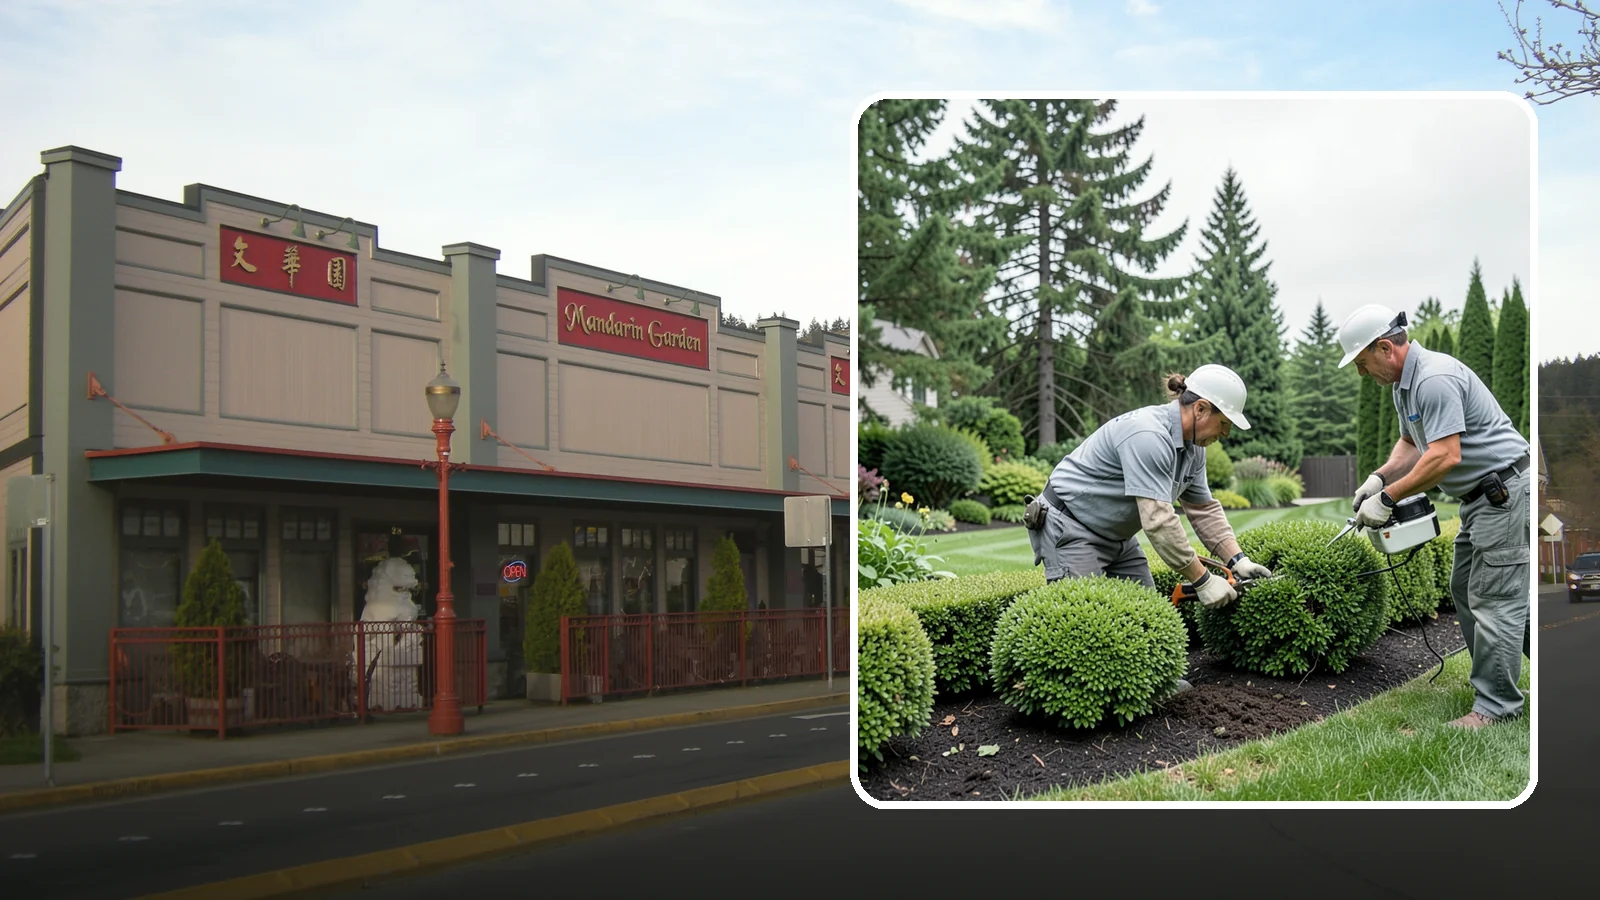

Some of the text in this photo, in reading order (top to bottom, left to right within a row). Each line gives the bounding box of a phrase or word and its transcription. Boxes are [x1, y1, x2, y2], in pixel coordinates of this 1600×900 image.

[231, 236, 346, 291] 文華園
[564, 302, 701, 352] Mandarin Garden
[503, 565, 527, 578] OPEN
